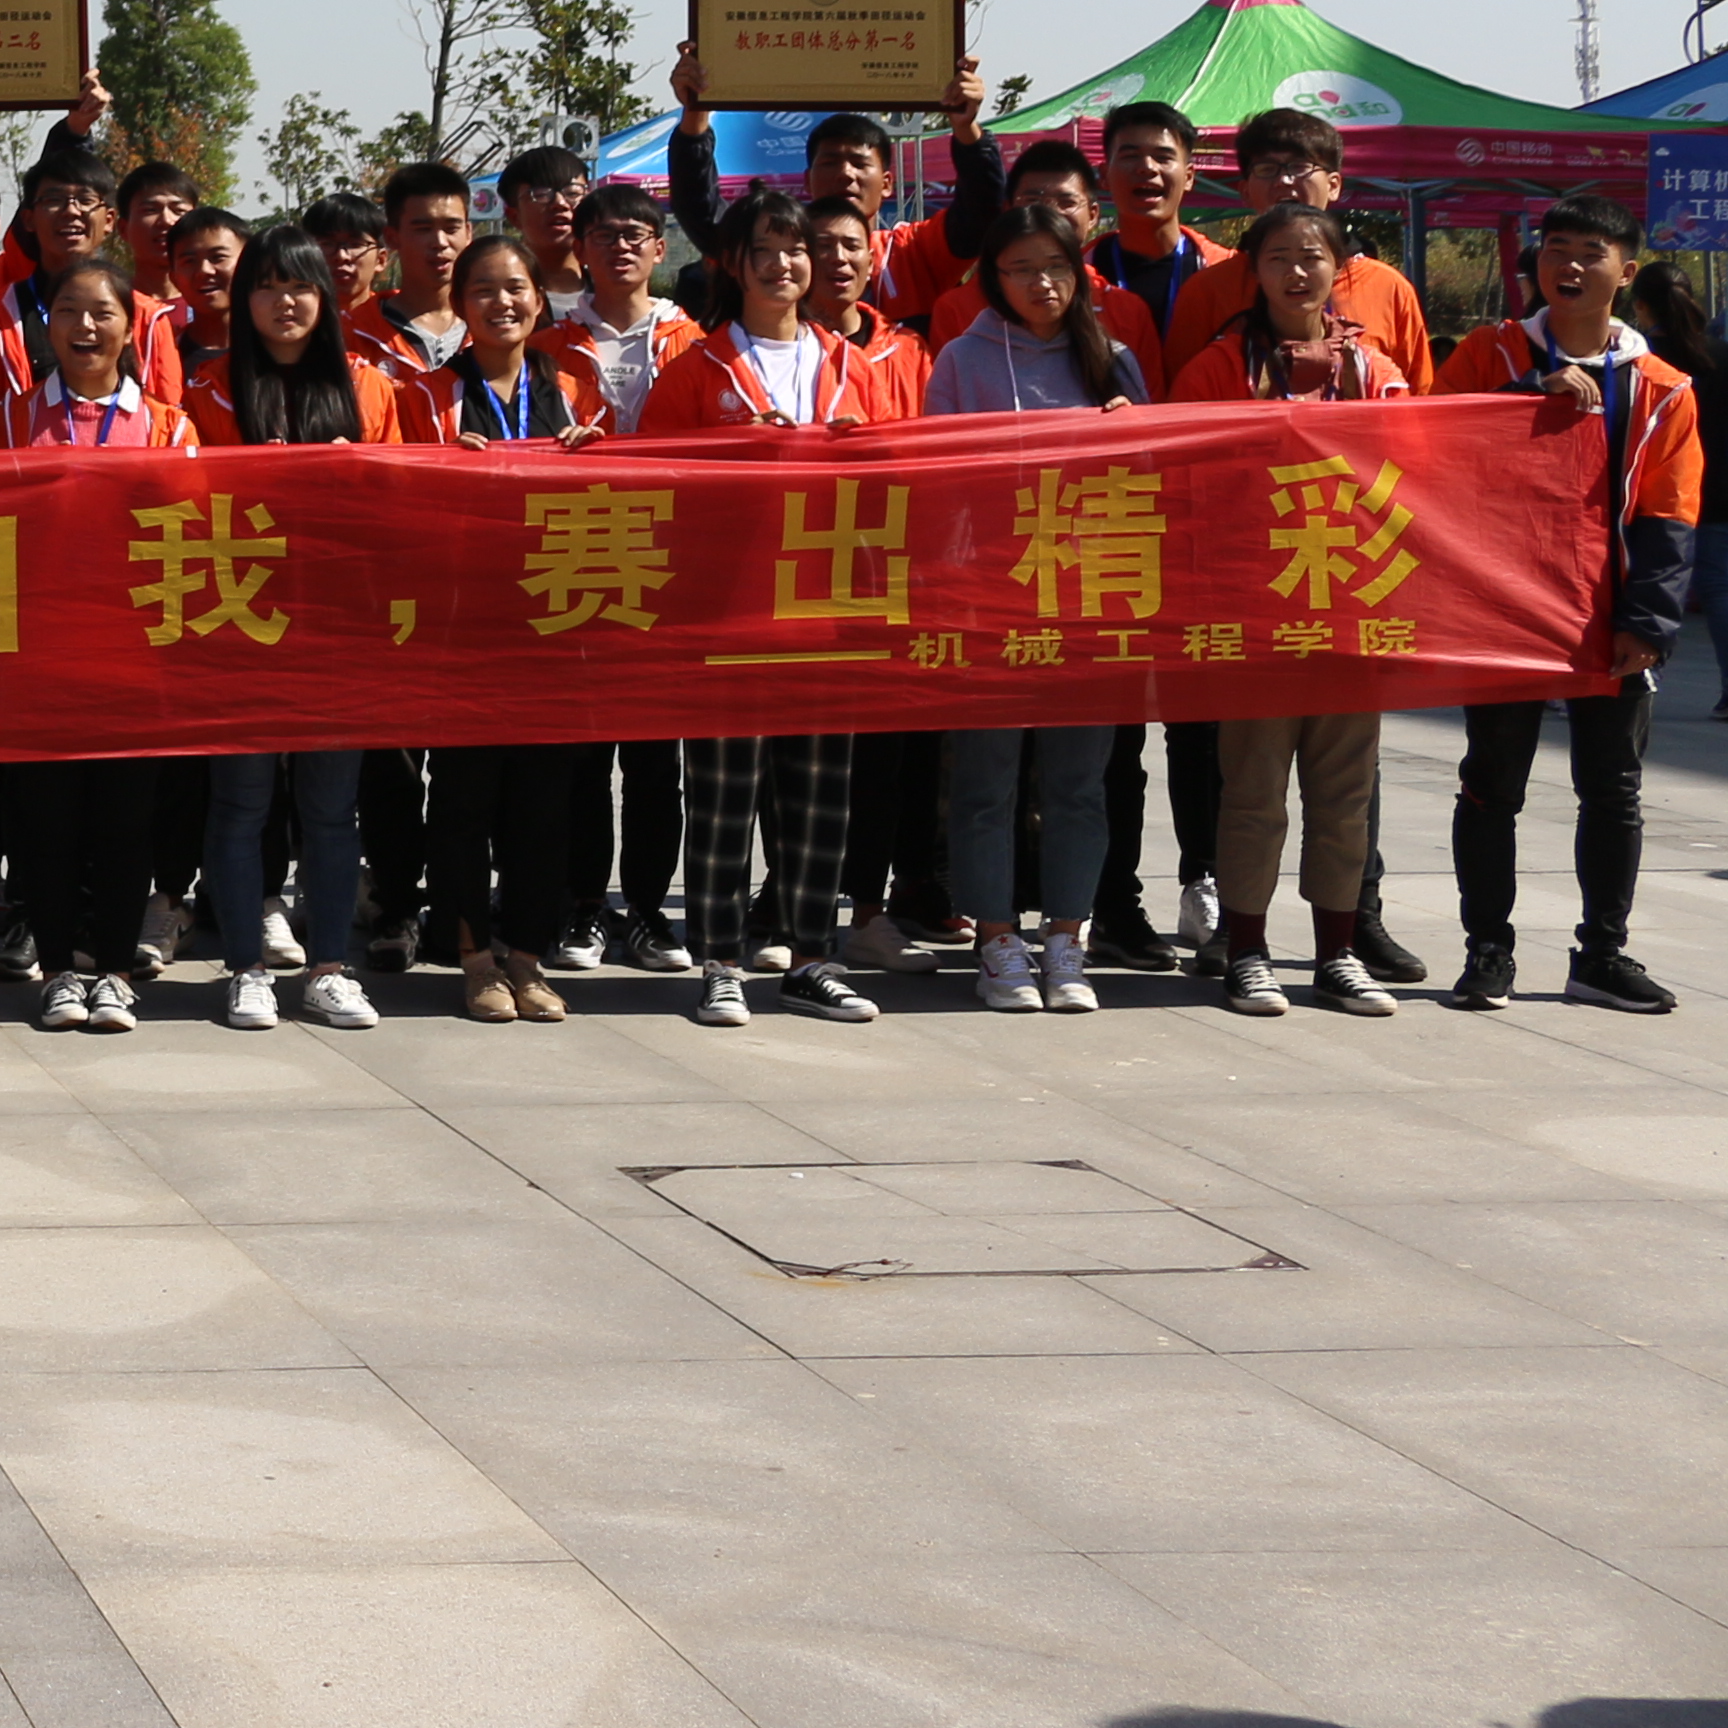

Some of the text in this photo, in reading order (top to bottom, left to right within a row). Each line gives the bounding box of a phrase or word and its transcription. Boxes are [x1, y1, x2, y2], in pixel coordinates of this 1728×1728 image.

[735, 29, 917, 52] 教职工团体总分第一名
